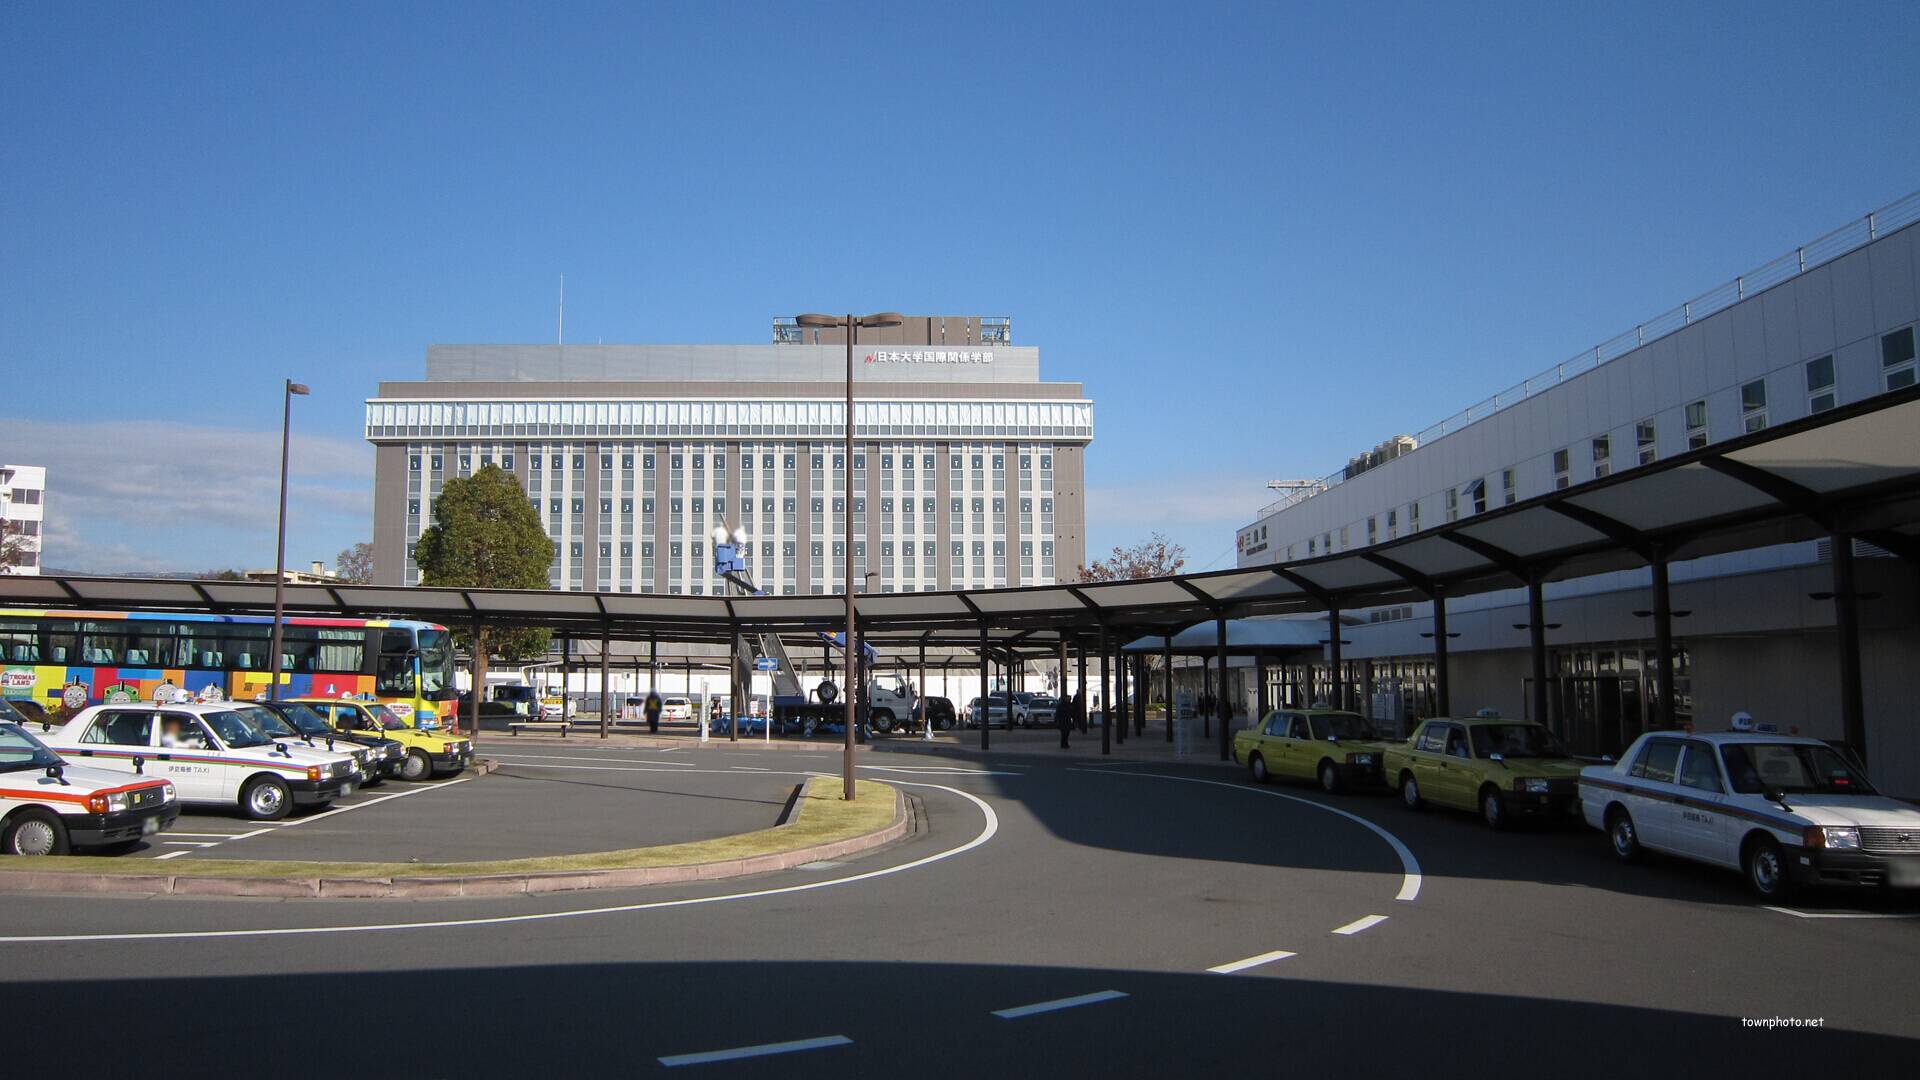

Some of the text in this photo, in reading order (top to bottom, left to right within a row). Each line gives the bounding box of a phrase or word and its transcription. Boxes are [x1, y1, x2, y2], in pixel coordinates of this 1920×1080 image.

[877, 351, 993, 364] 日本大学国際関係学部
[193, 766, 210, 774] TAXI
